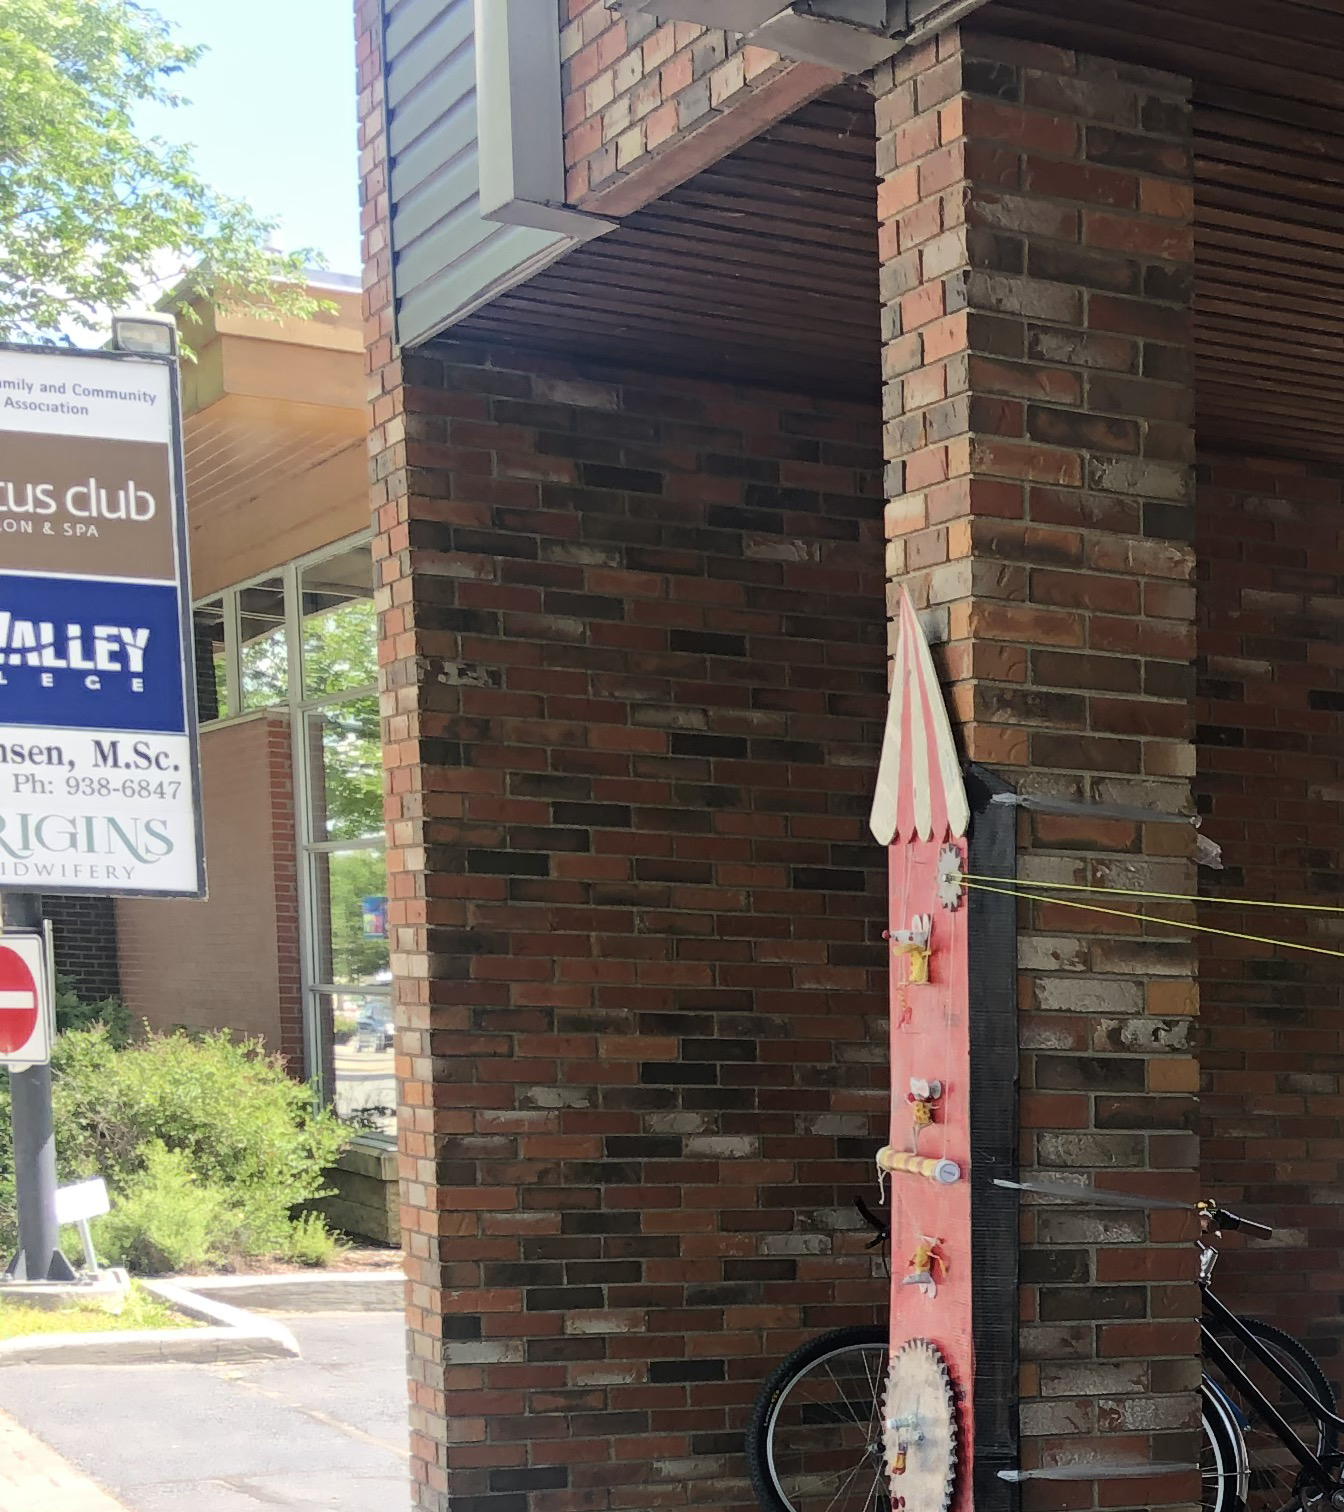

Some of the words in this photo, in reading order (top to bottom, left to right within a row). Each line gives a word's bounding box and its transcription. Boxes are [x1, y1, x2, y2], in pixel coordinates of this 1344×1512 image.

[0, 377, 34, 395] mily
[39, 381, 66, 395] and
[72, 383, 157, 406] Community
[4, 396, 90, 416] Association
[65, 477, 156, 521] club
[0, 518, 33, 534] ON
[42, 521, 56, 535] &
[63, 522, 99, 538] SPA
[92, 739, 181, 772] M.Sc.
[12, 773, 54, 795] Ph:
[66, 776, 182, 800] 938-6847
